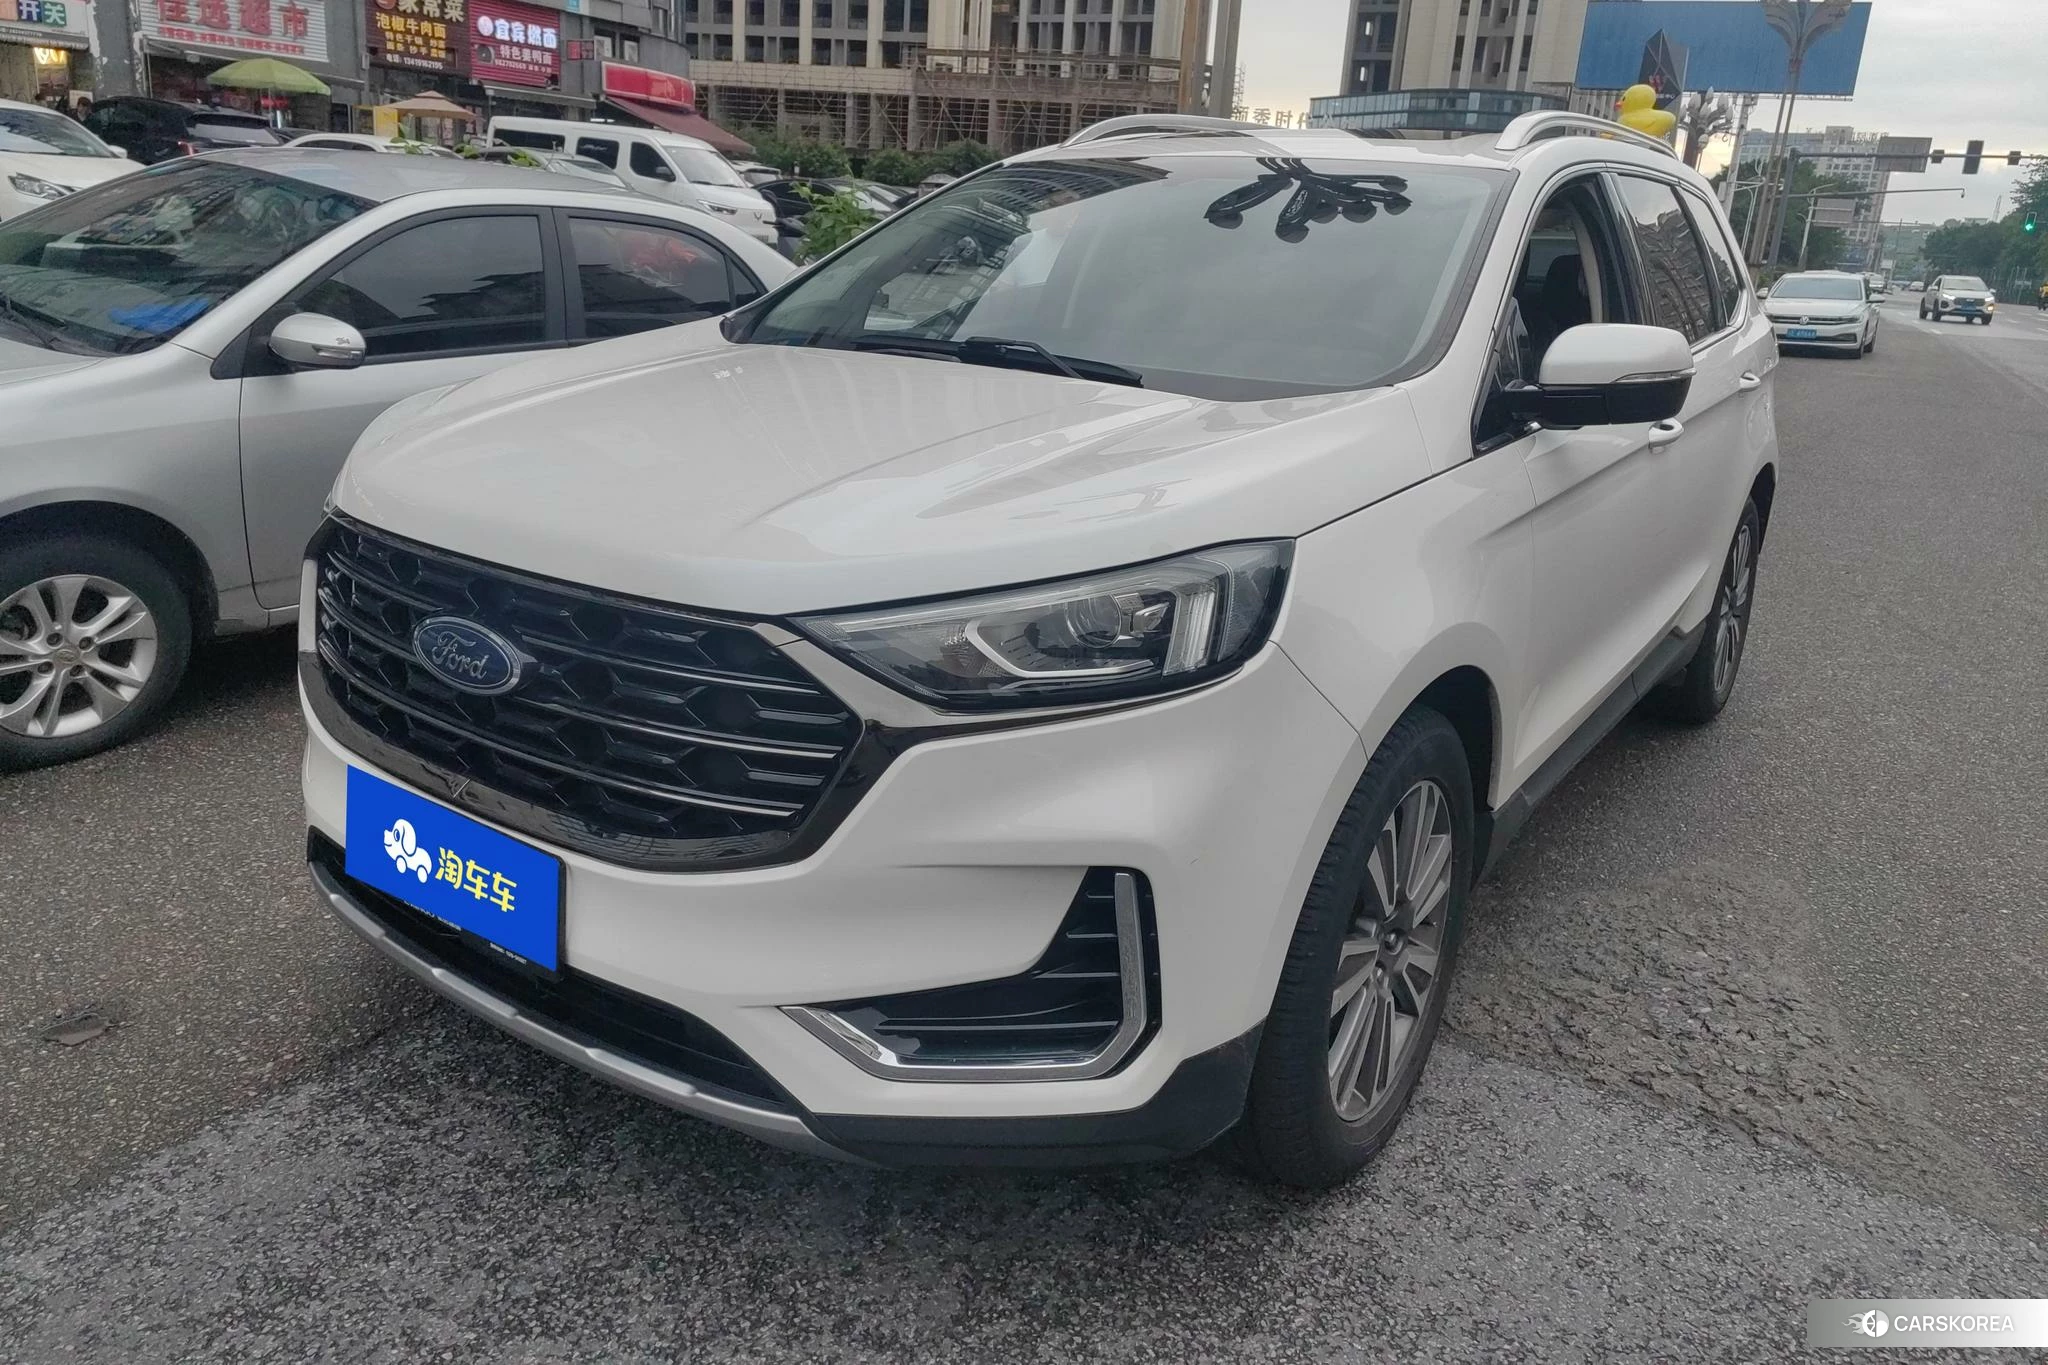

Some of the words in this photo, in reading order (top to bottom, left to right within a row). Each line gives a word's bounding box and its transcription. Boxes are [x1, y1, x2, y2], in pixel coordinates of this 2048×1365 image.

[20, 0, 65, 24] 开关
[495, 18, 557, 49] 宜宾燃面
[431, 632, 489, 680] Ford
